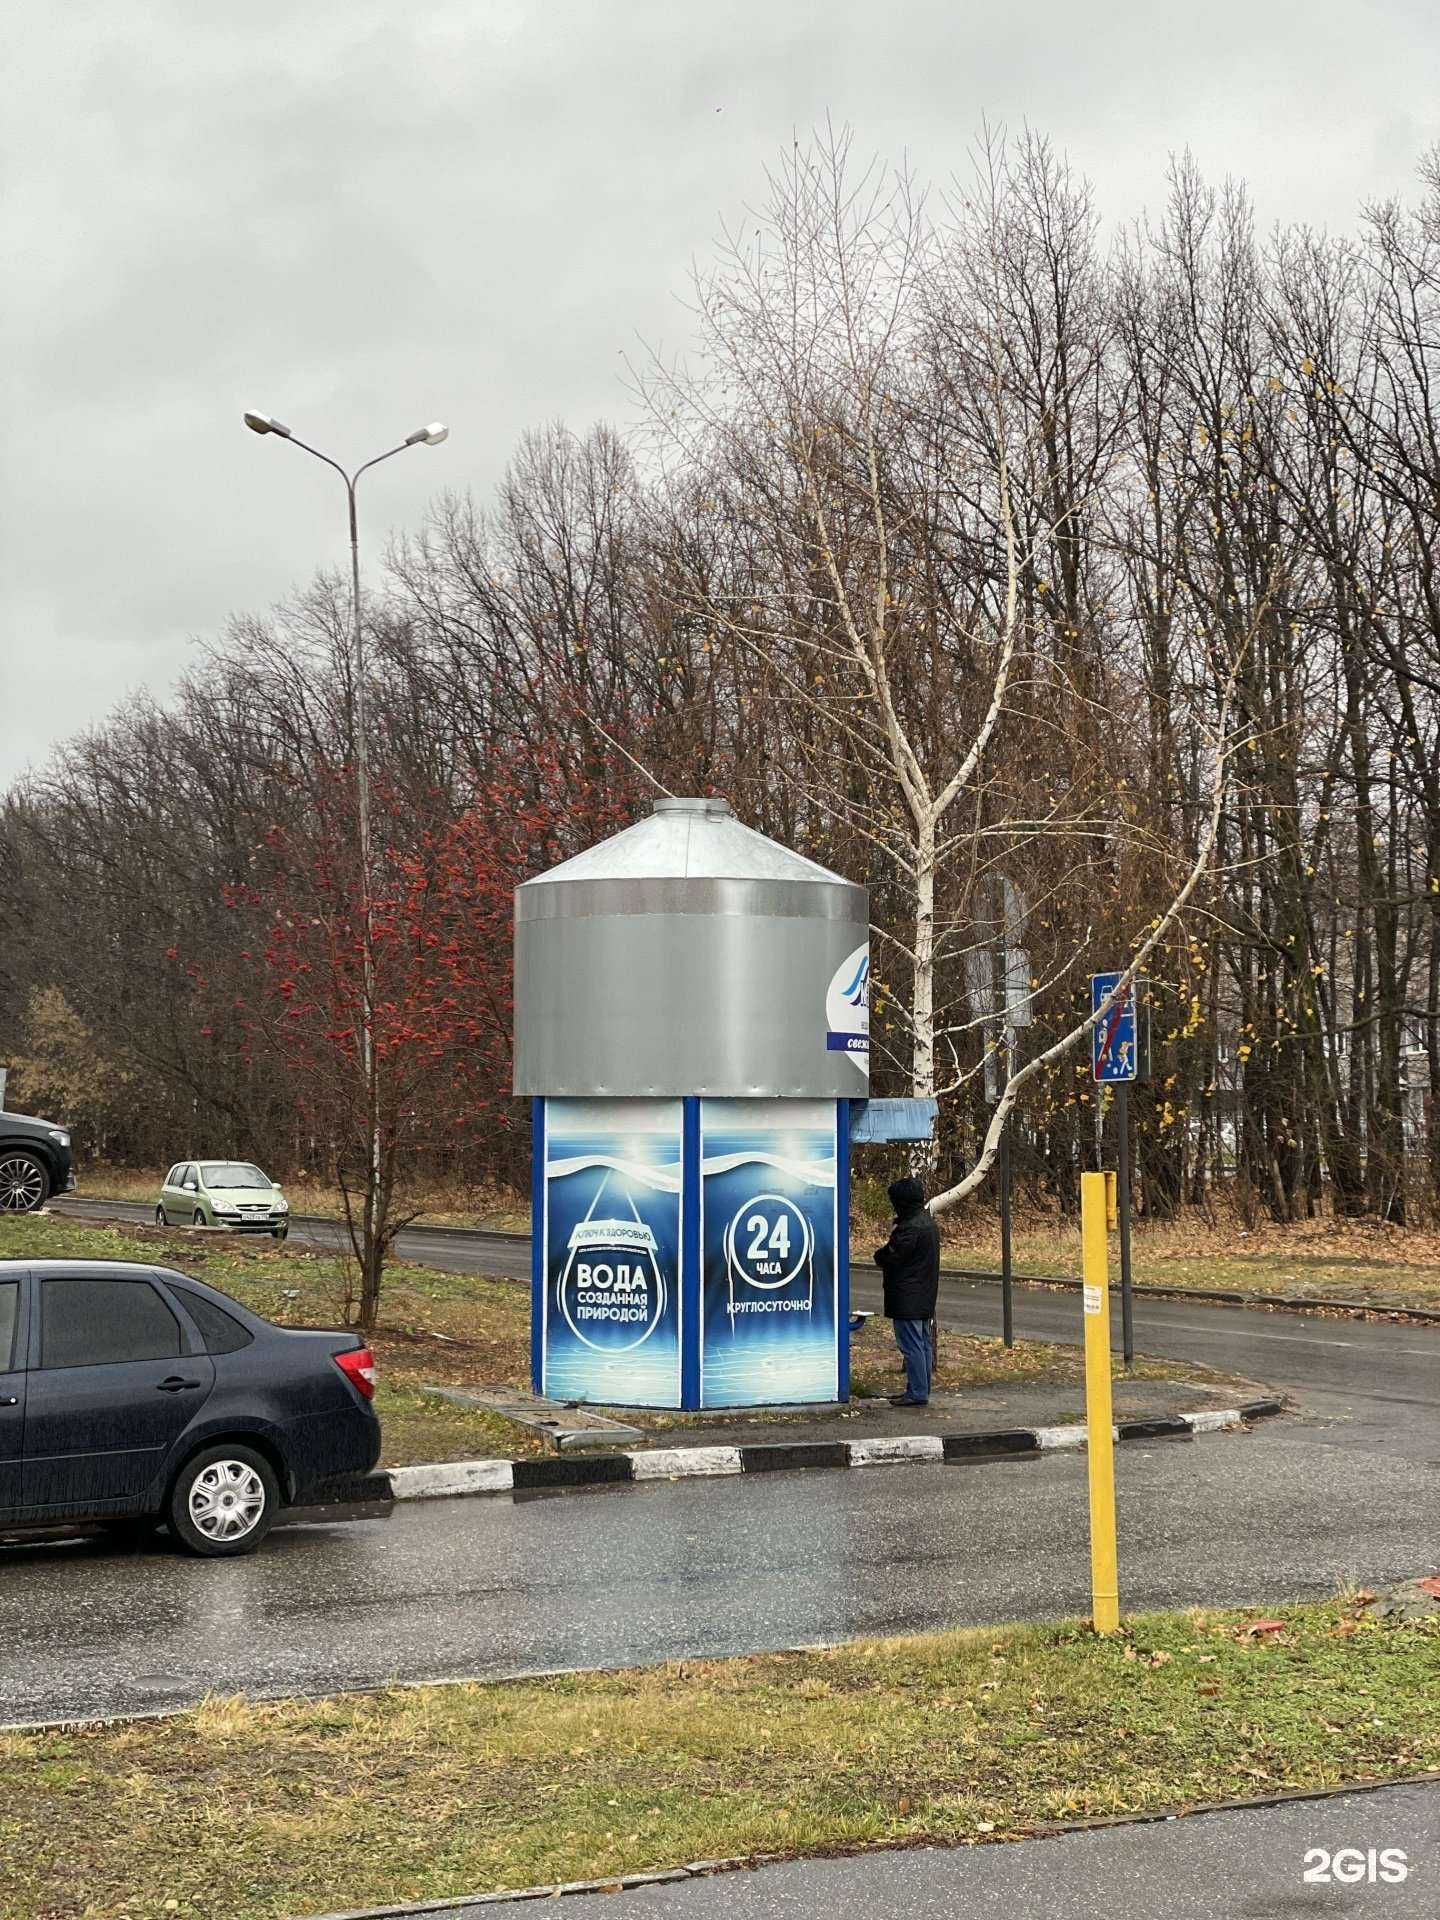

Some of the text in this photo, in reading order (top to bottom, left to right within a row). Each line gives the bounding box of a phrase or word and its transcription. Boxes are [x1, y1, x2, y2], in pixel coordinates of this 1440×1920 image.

[606, 1228, 651, 1241] ЗДОРОВЬЮ
[746, 1214, 791, 1259] 24
[756, 1261, 782, 1275] ЧАСА
[577, 1263, 648, 1292] ВОДА
[577, 1292, 648, 1306] СОЗДАННАЯ
[726, 1299, 811, 1314] КРУГЛОСУТОЧНО
[577, 1305, 648, 1323] ПРИРОДОЙ
